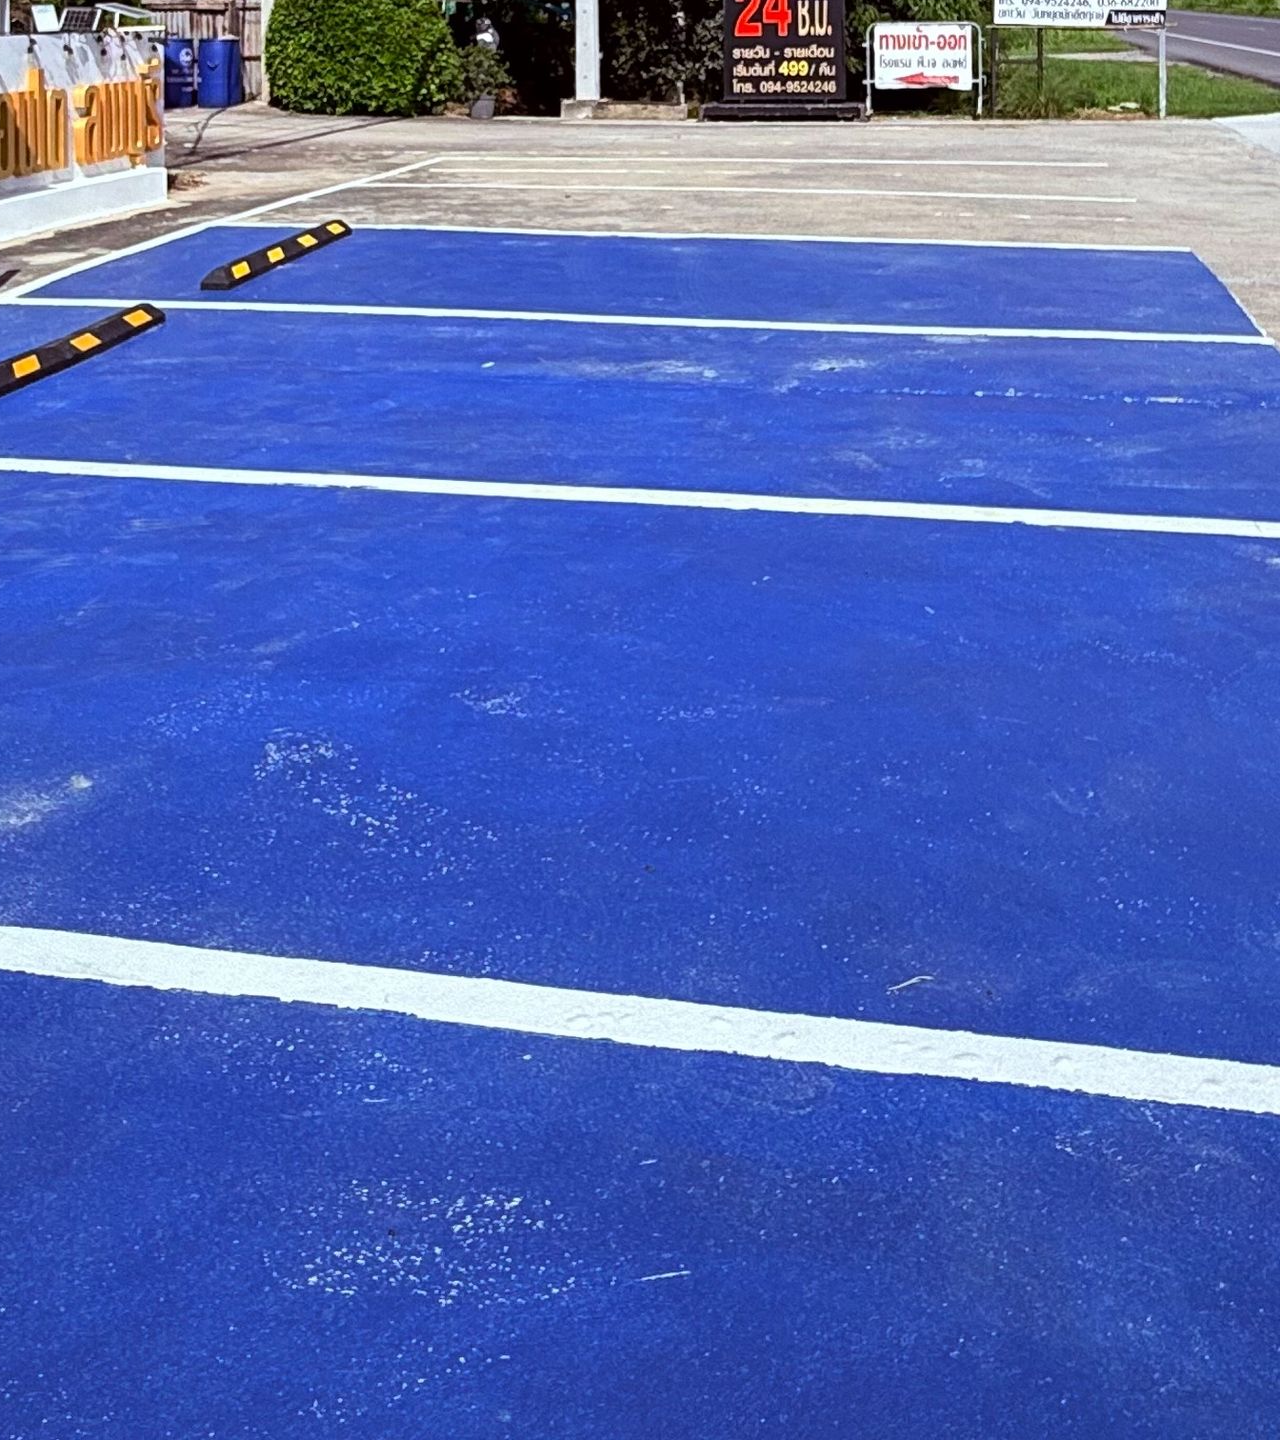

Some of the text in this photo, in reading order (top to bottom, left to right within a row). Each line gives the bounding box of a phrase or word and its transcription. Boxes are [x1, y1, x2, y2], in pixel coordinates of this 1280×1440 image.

[797, 0, 833, 36] ช.ม.
[879, 26, 967, 50] ทางเข้า-ออก
[732, 45, 770, 58] รายวัน
[784, 44, 835, 58] รายเดือน
[733, 60, 776, 76] เริ่มต้นที่
[732, 79, 837, 94] โทร. 094-9524246
